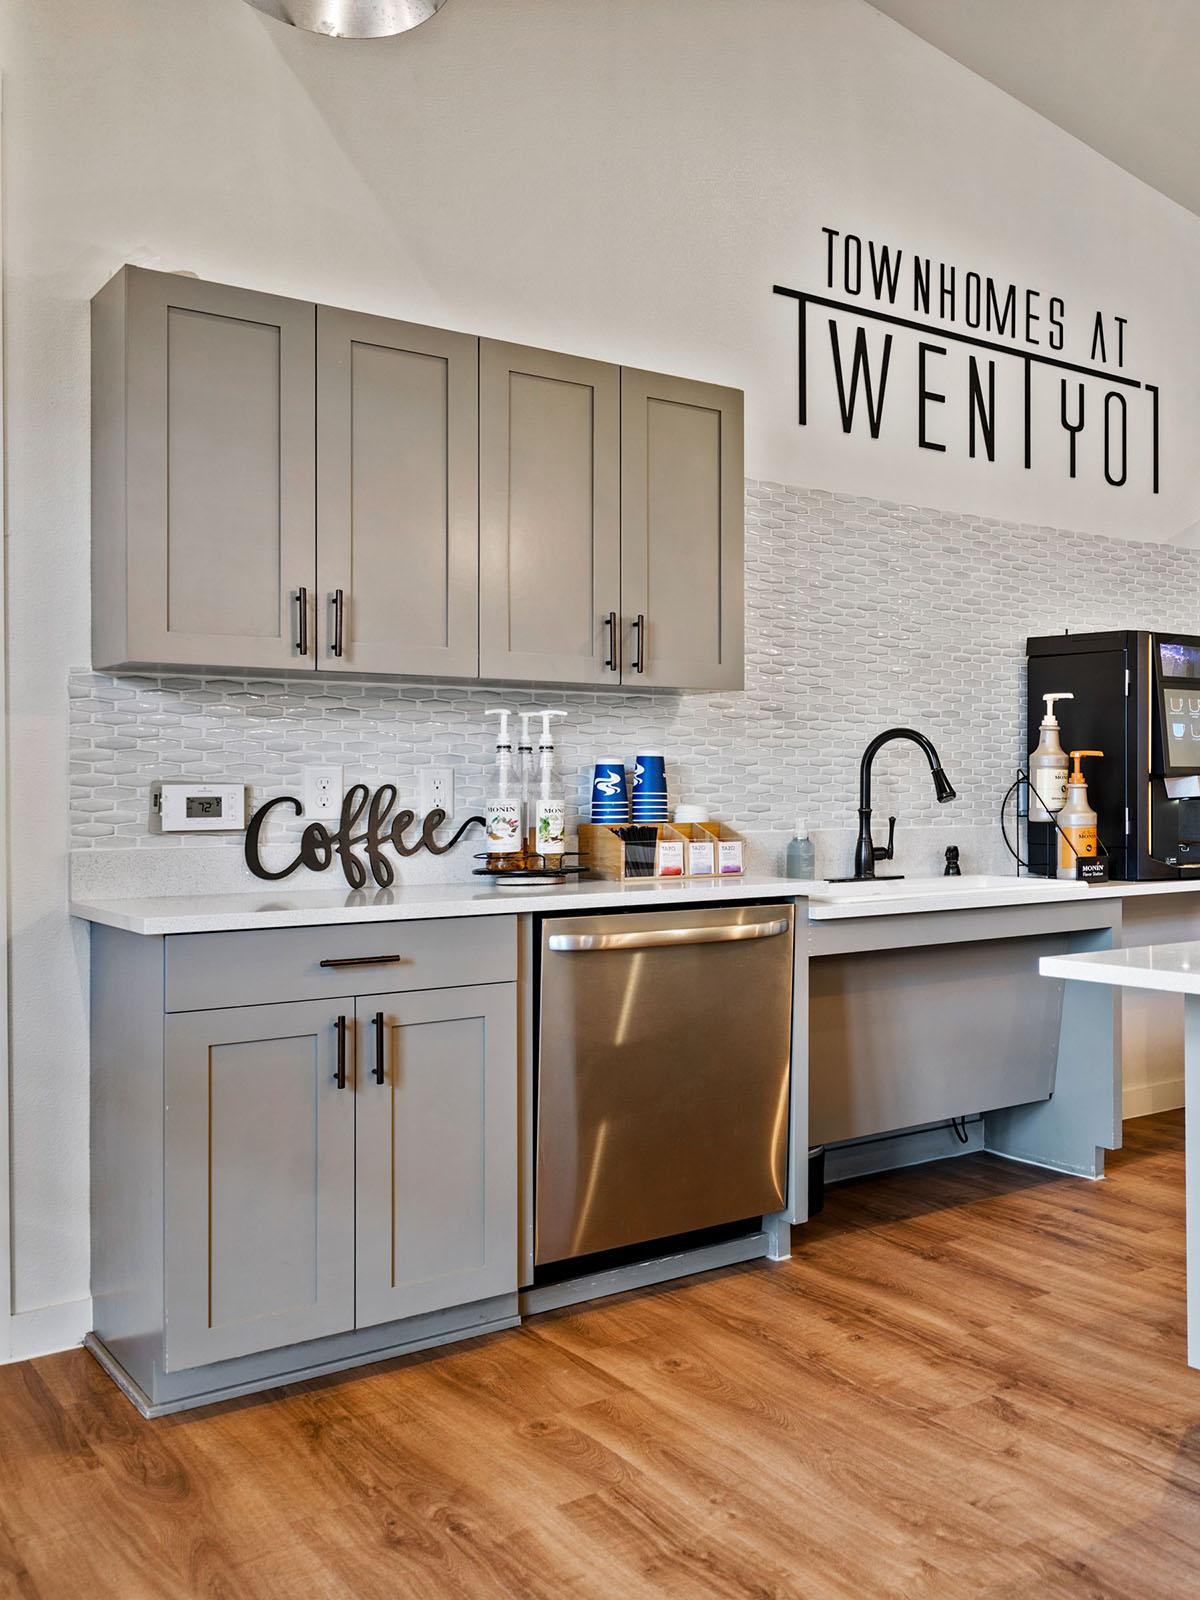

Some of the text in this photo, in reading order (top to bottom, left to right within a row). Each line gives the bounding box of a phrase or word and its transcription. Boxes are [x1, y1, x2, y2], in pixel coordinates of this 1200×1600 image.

[821, 226, 1128, 368] TOWNHOMES AT
[198, 801, 212, 813] 72
[244, 784, 486, 889] Coffee
[1082, 864, 1104, 872] MONIN
